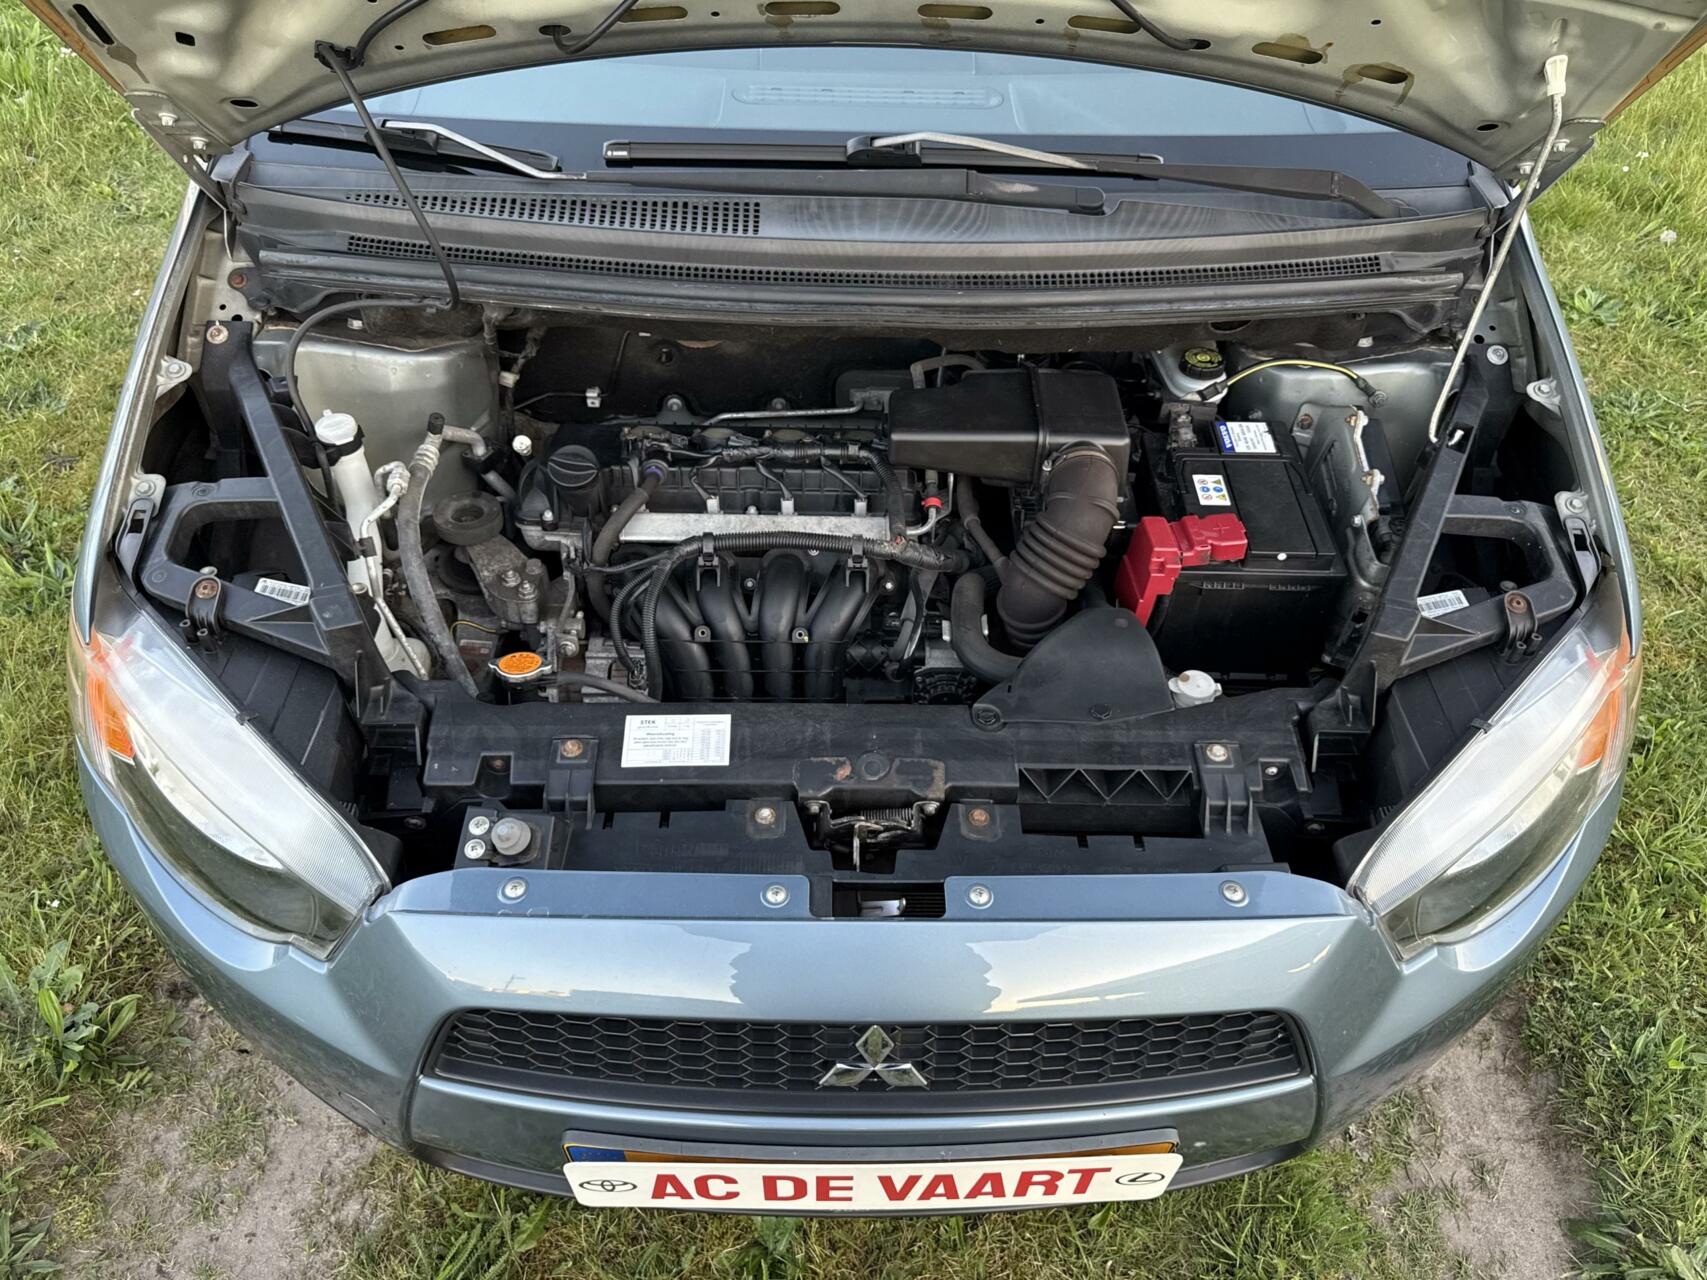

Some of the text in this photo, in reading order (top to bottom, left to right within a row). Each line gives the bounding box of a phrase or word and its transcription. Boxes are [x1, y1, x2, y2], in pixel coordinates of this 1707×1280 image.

[651, 1167, 1112, 1201] AC DE VAART
